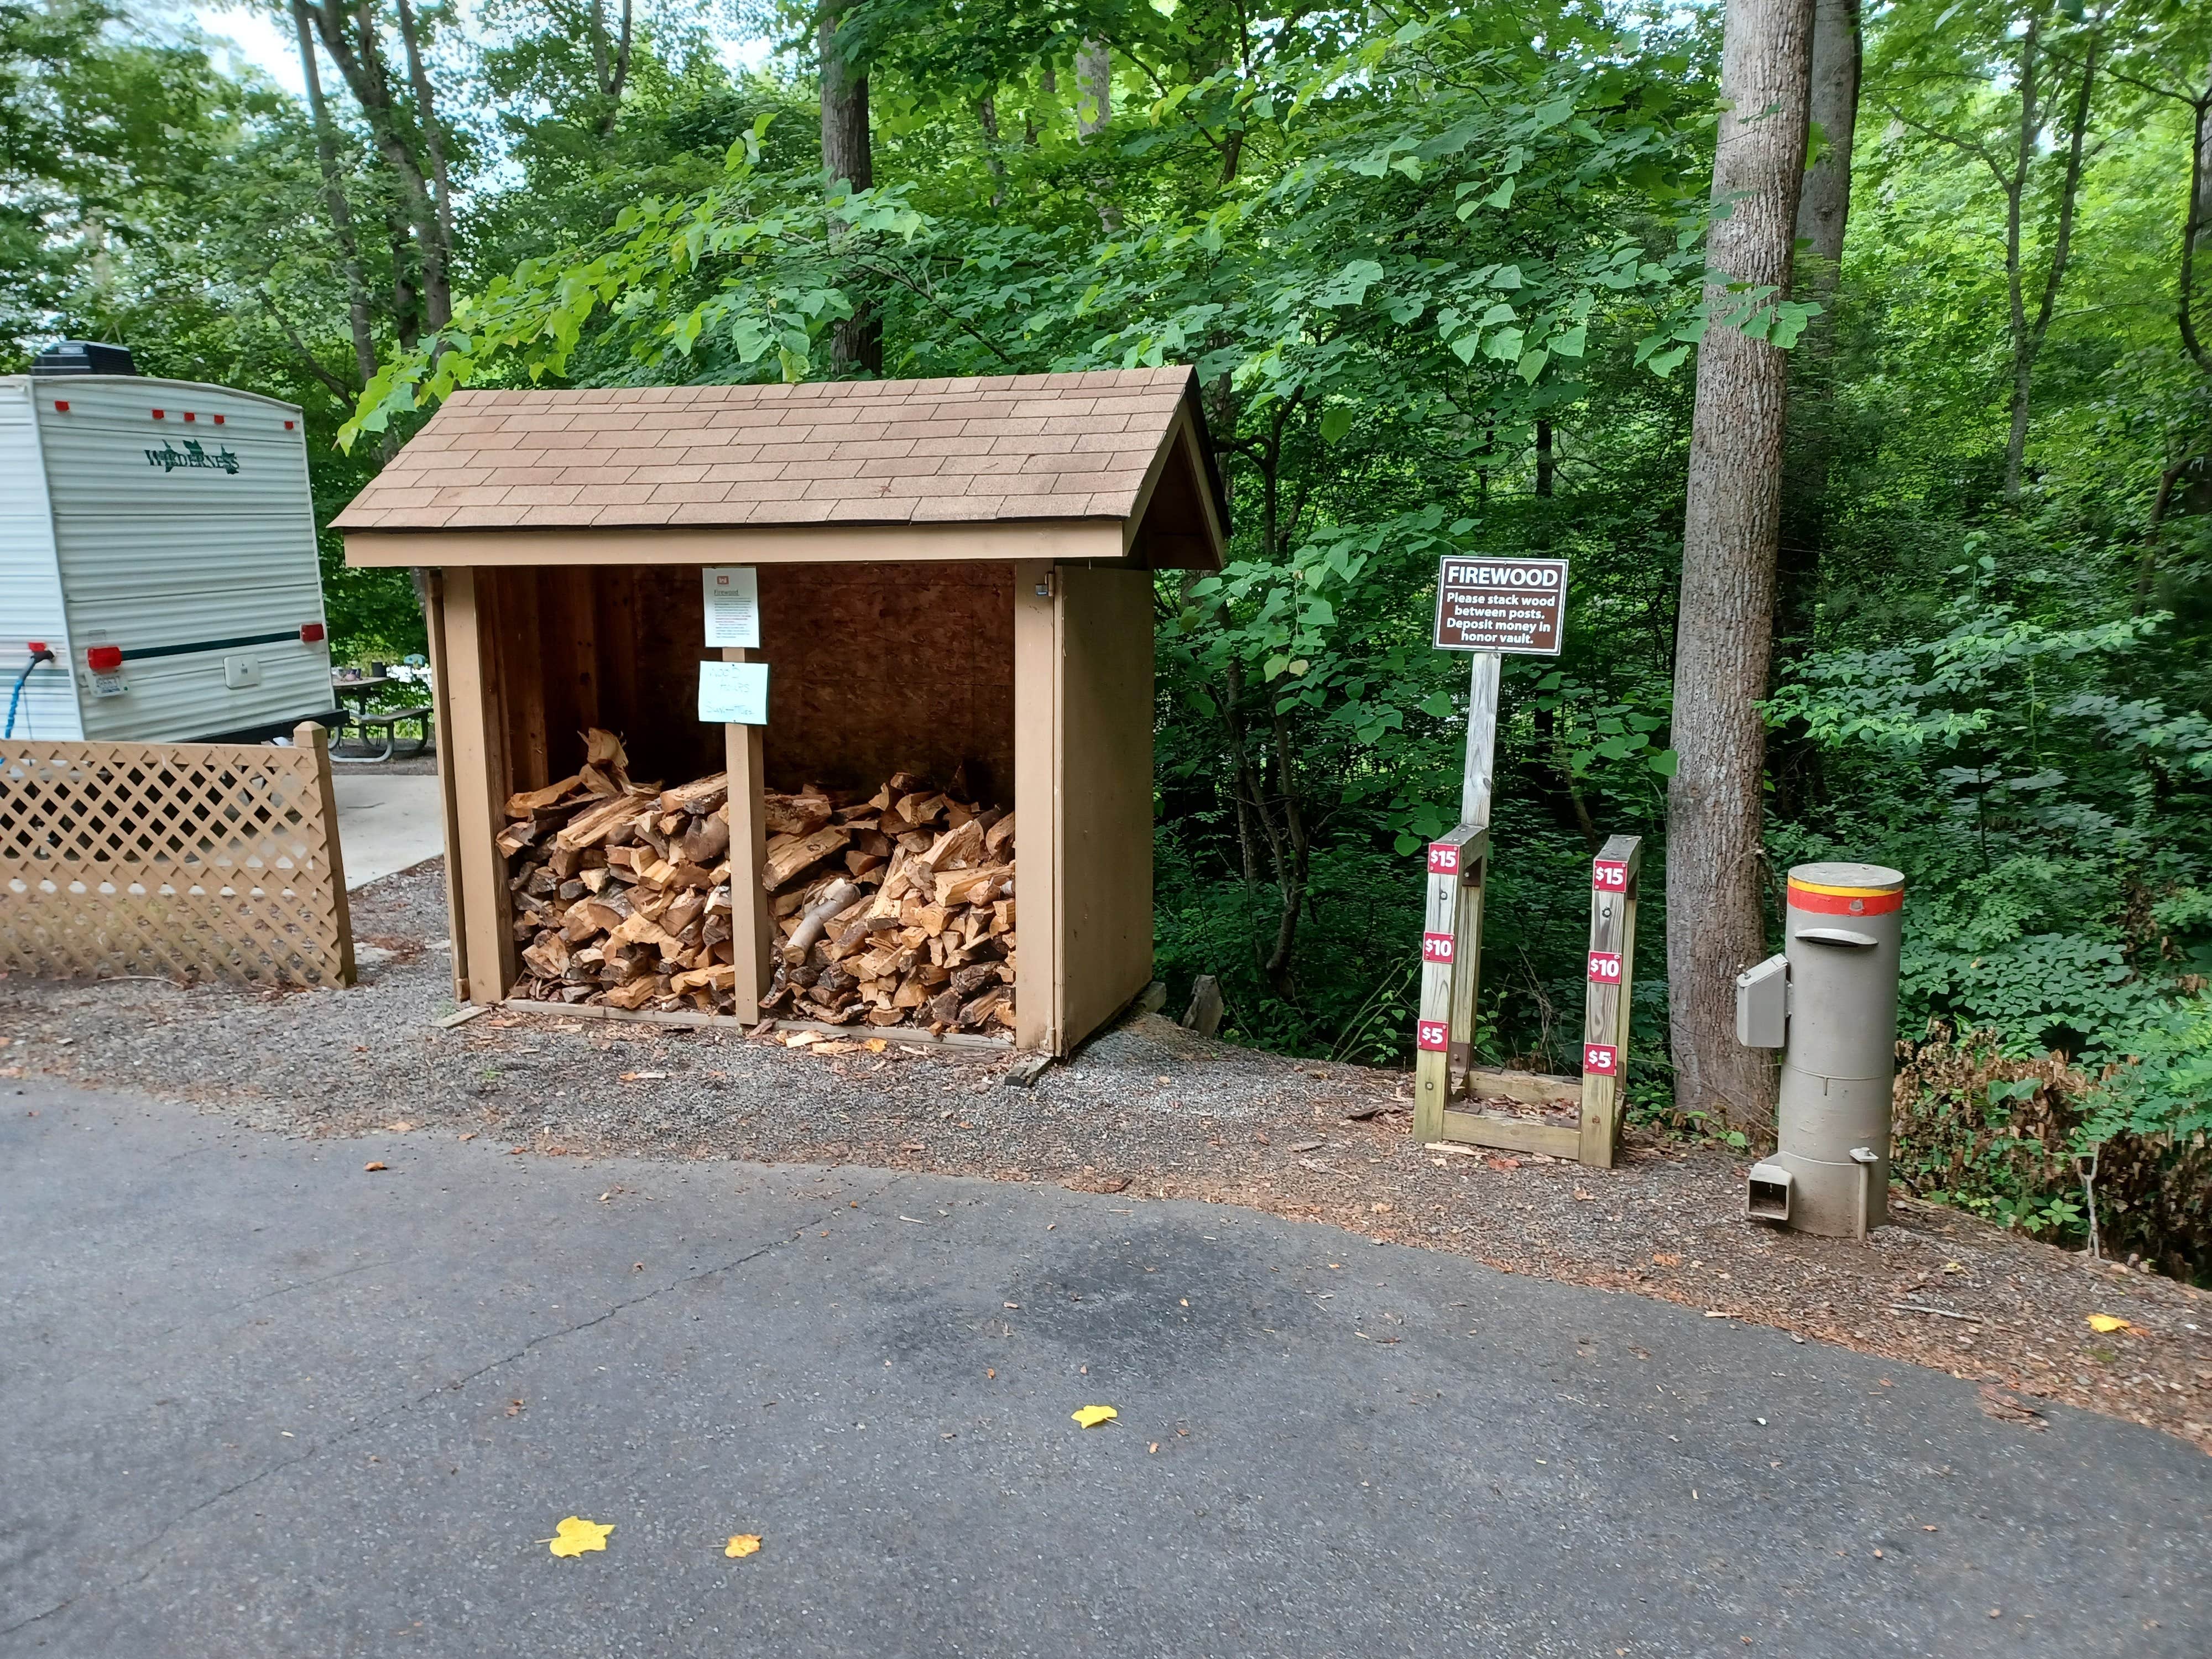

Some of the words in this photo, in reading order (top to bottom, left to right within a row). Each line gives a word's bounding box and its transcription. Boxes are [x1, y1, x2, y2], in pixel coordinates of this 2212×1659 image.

[1448, 566, 1559, 587] FIREWOOD
[1447, 592, 1485, 604] Please
[1488, 594, 1519, 606] stack
[1521, 596, 1556, 607] wood
[1454, 606, 1506, 618] between
[1509, 610, 1545, 620] posts.
[1447, 618, 1493, 630] Deposit
[1495, 622, 1537, 633] money
[1539, 622, 1551, 632] in
[1461, 631, 1498, 642] honor
[1500, 633, 1534, 644] vault.
[1430, 849, 1457, 868] $15
[1595, 866, 1624, 885] $15
[1425, 938, 1452, 957] $10
[1590, 957, 1620, 977] $10
[1422, 1026, 1443, 1045] $5
[1588, 1050, 1612, 1068] $5
